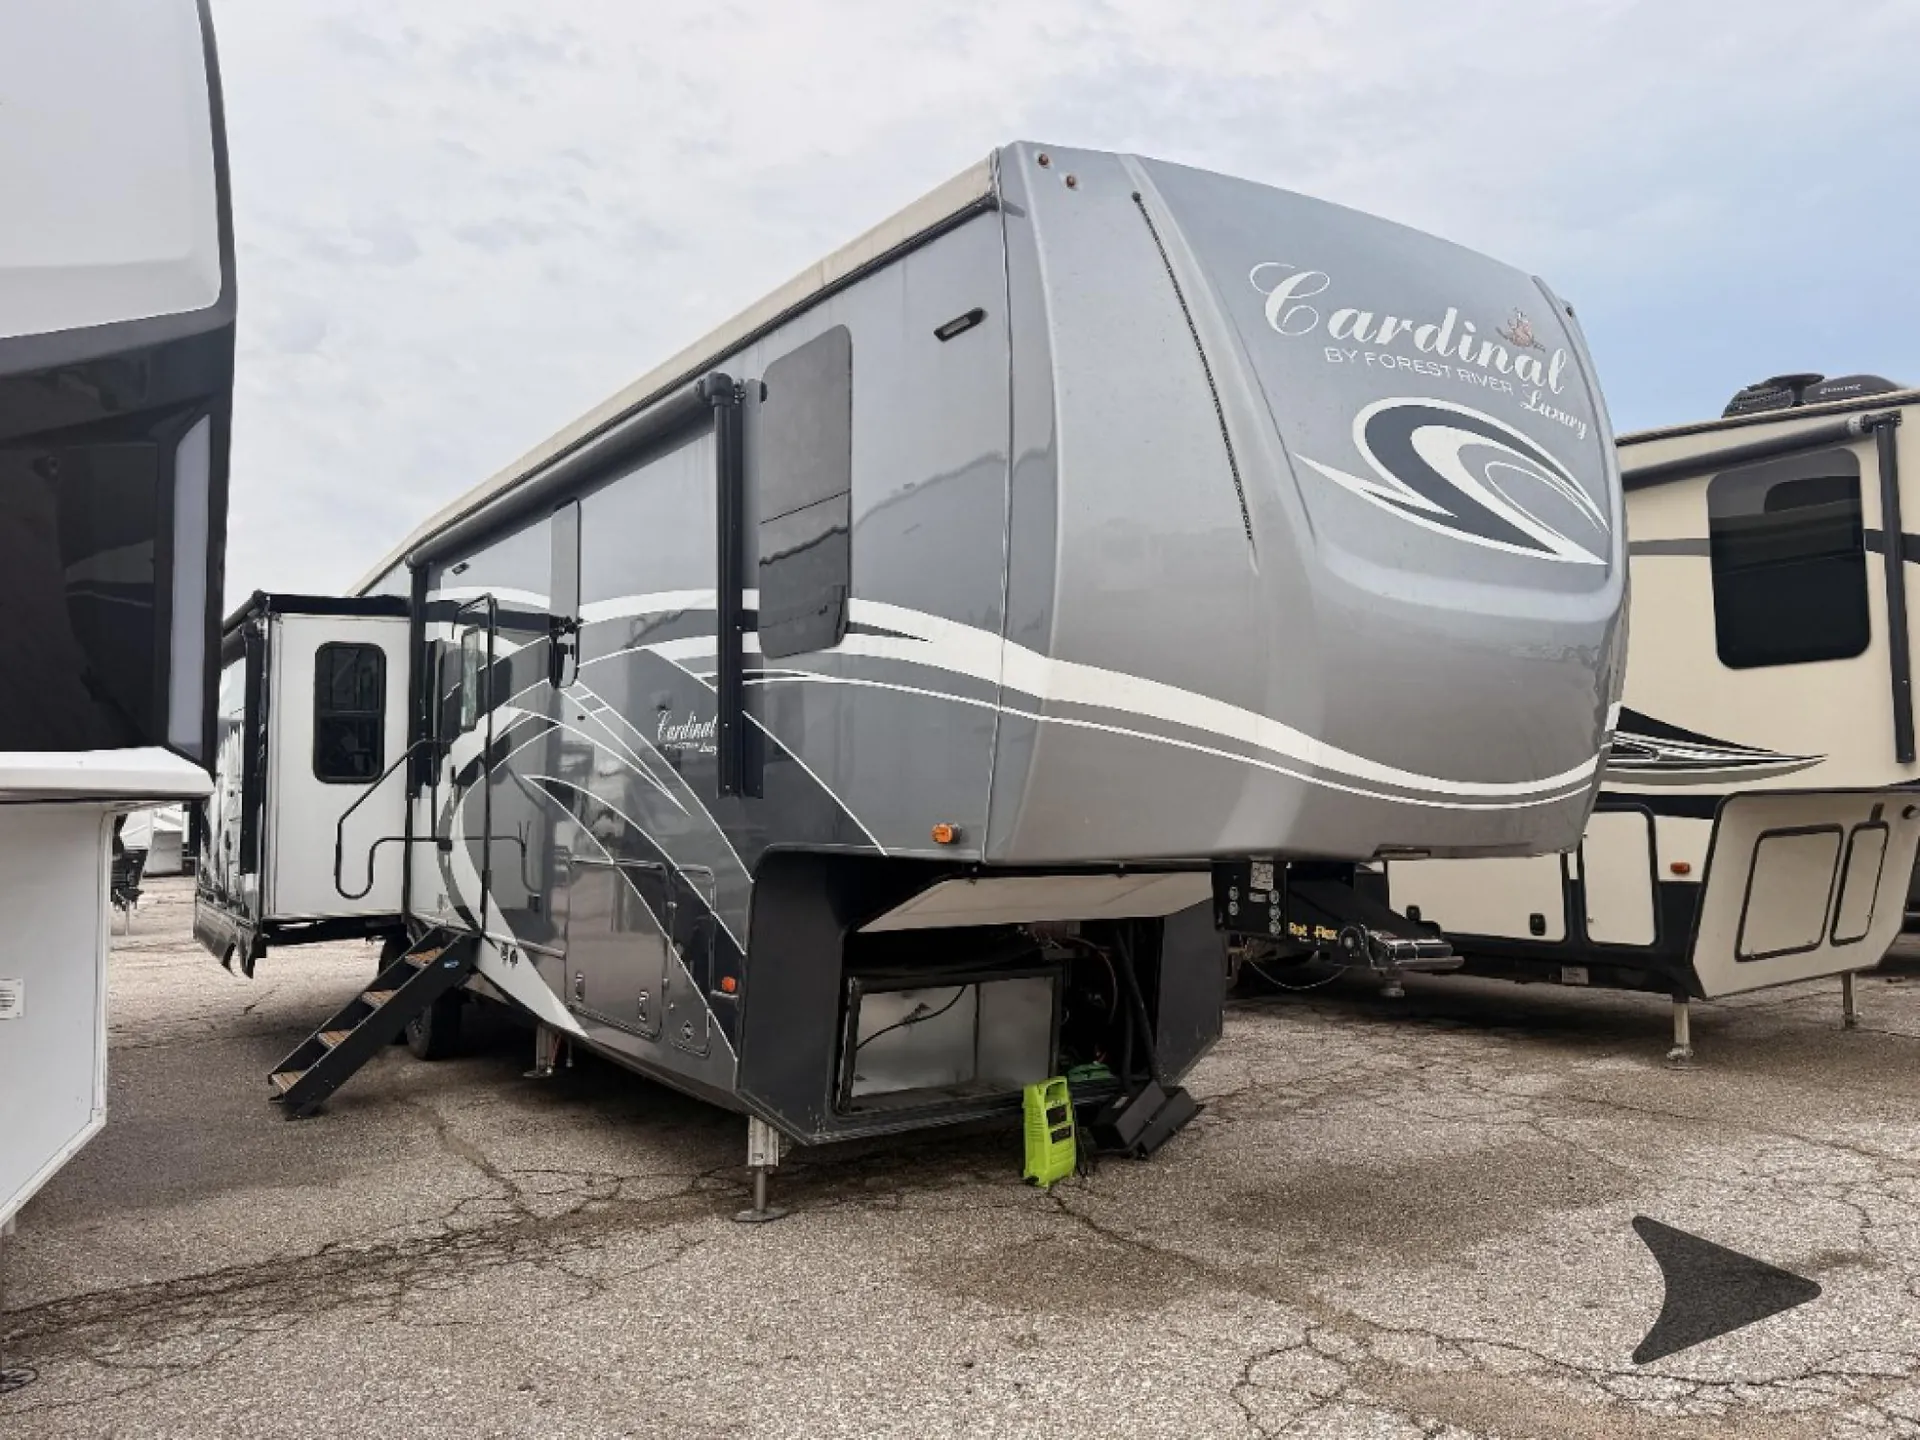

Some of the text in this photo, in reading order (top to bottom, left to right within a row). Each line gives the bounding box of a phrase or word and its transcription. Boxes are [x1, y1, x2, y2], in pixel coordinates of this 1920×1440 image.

[1250, 262, 1567, 395] Cardinal
[1324, 347, 1514, 395] BY FOREST RIVER
[1520, 388, 1587, 440] Luxury
[657, 710, 719, 741] Cardinal
